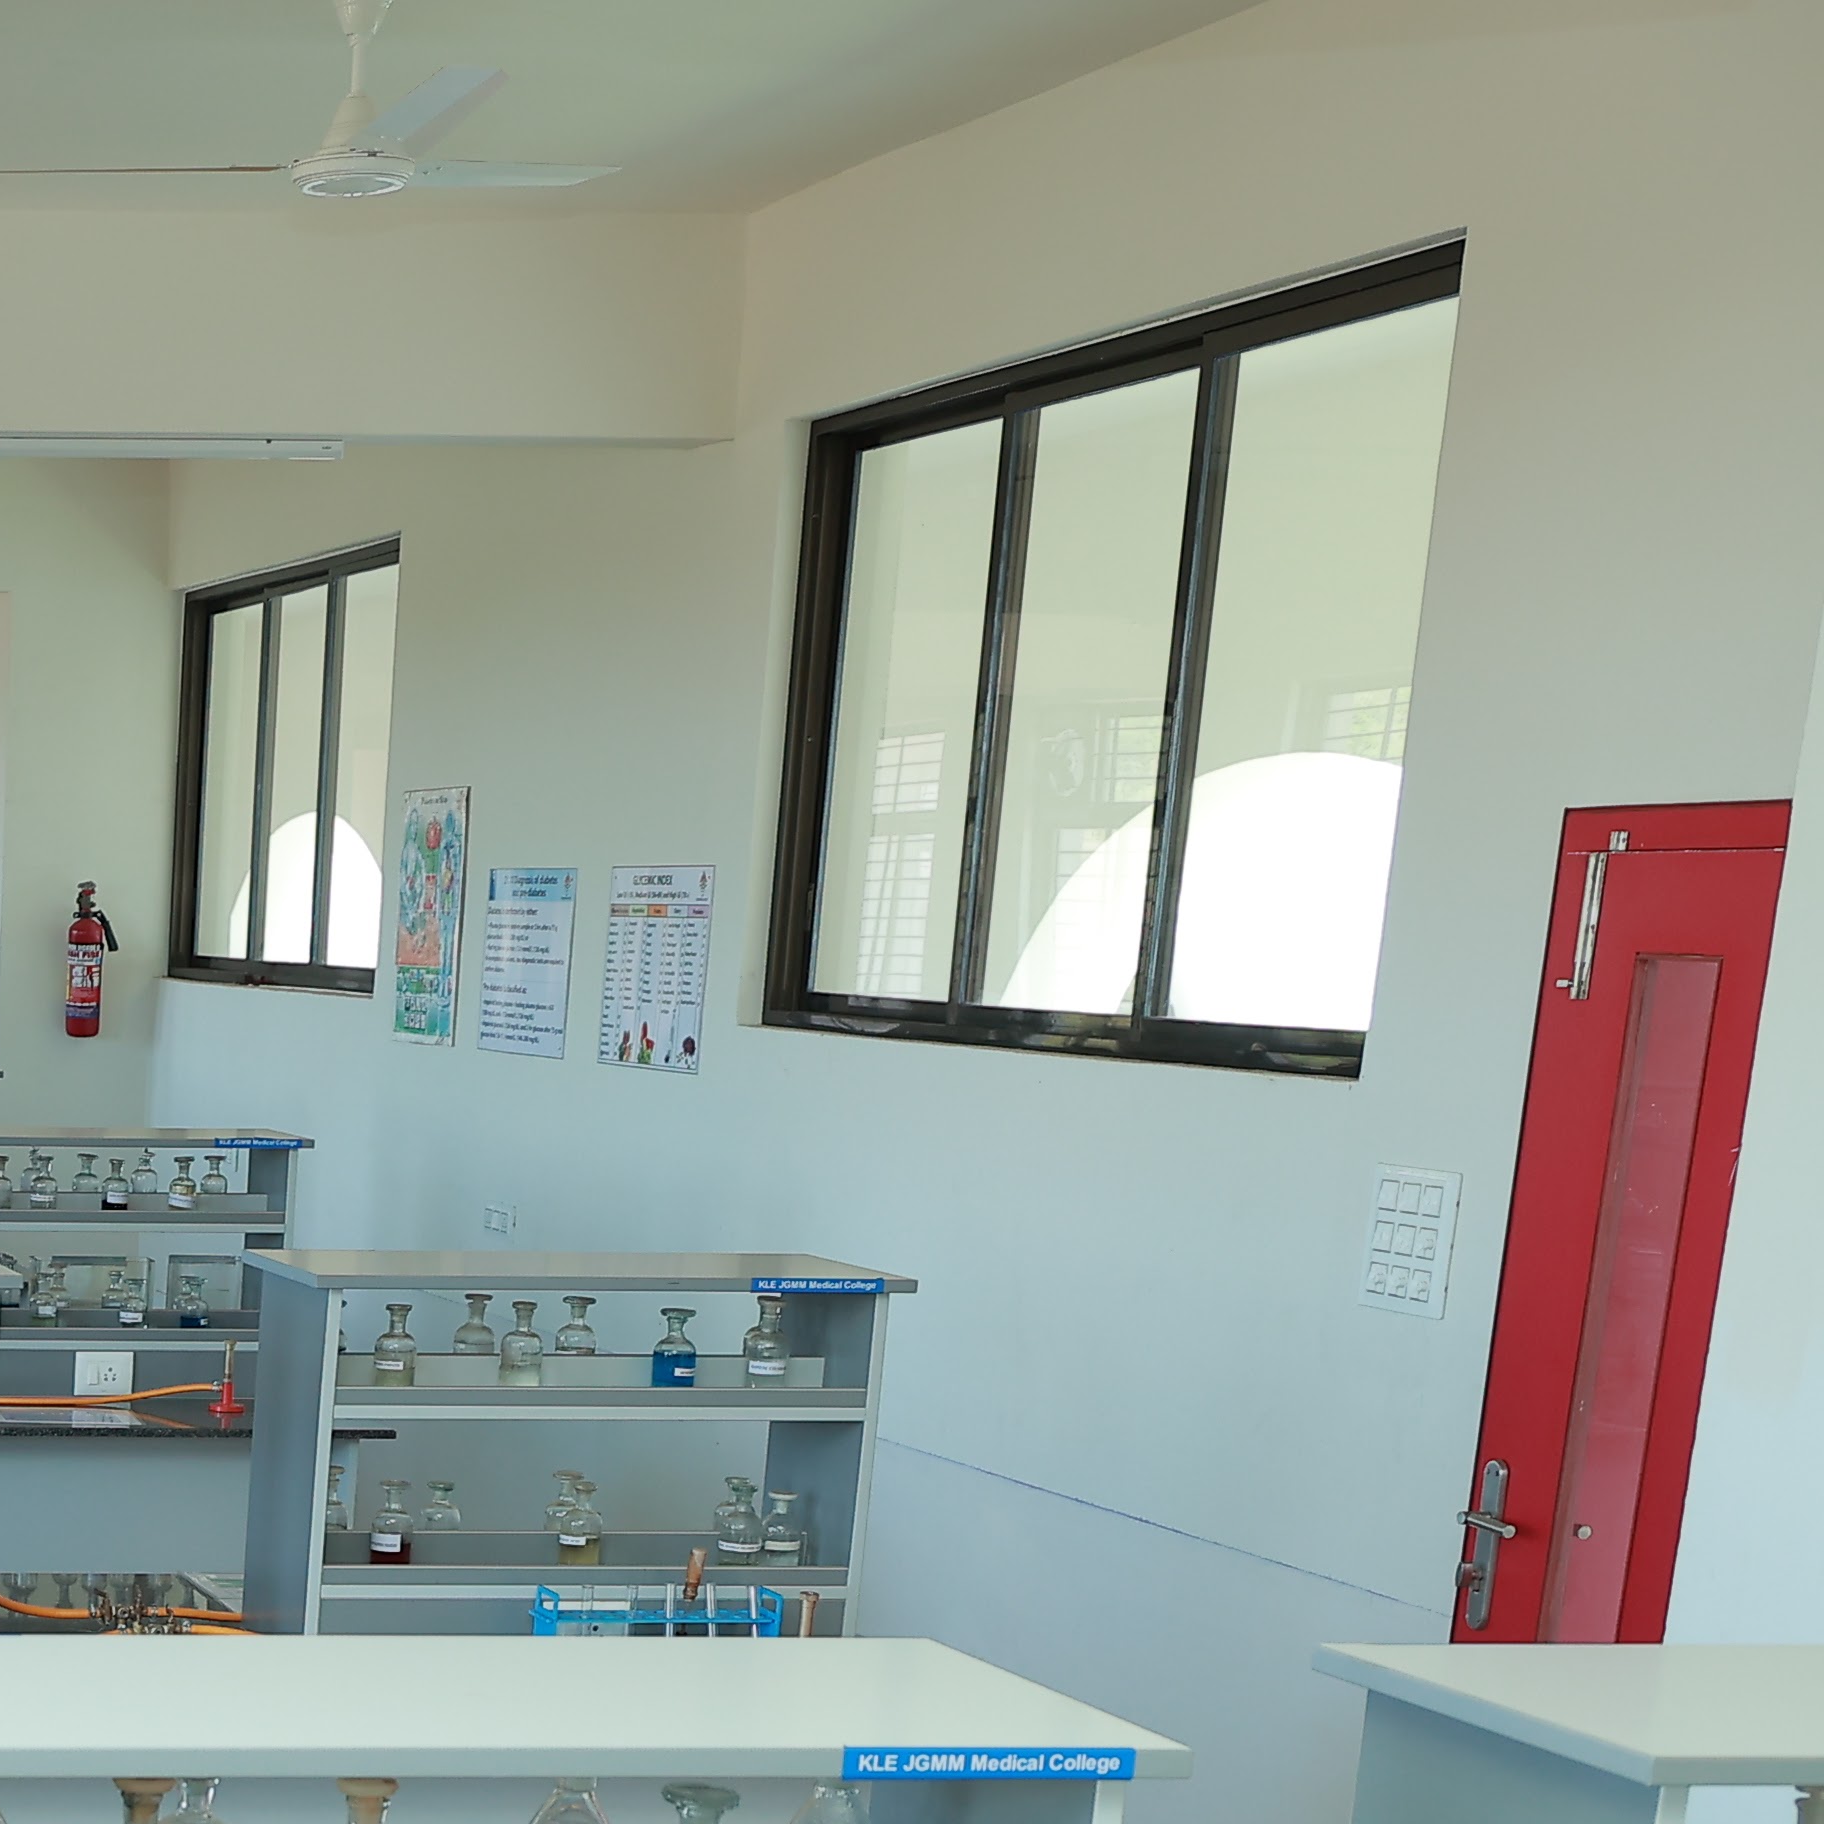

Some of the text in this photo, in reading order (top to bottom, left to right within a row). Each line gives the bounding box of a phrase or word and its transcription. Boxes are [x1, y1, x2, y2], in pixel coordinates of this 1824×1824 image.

[758, 1280, 877, 1291] KLE JGMM Medical College
[857, 1754, 1121, 1775] KLE JGMM Medical College
